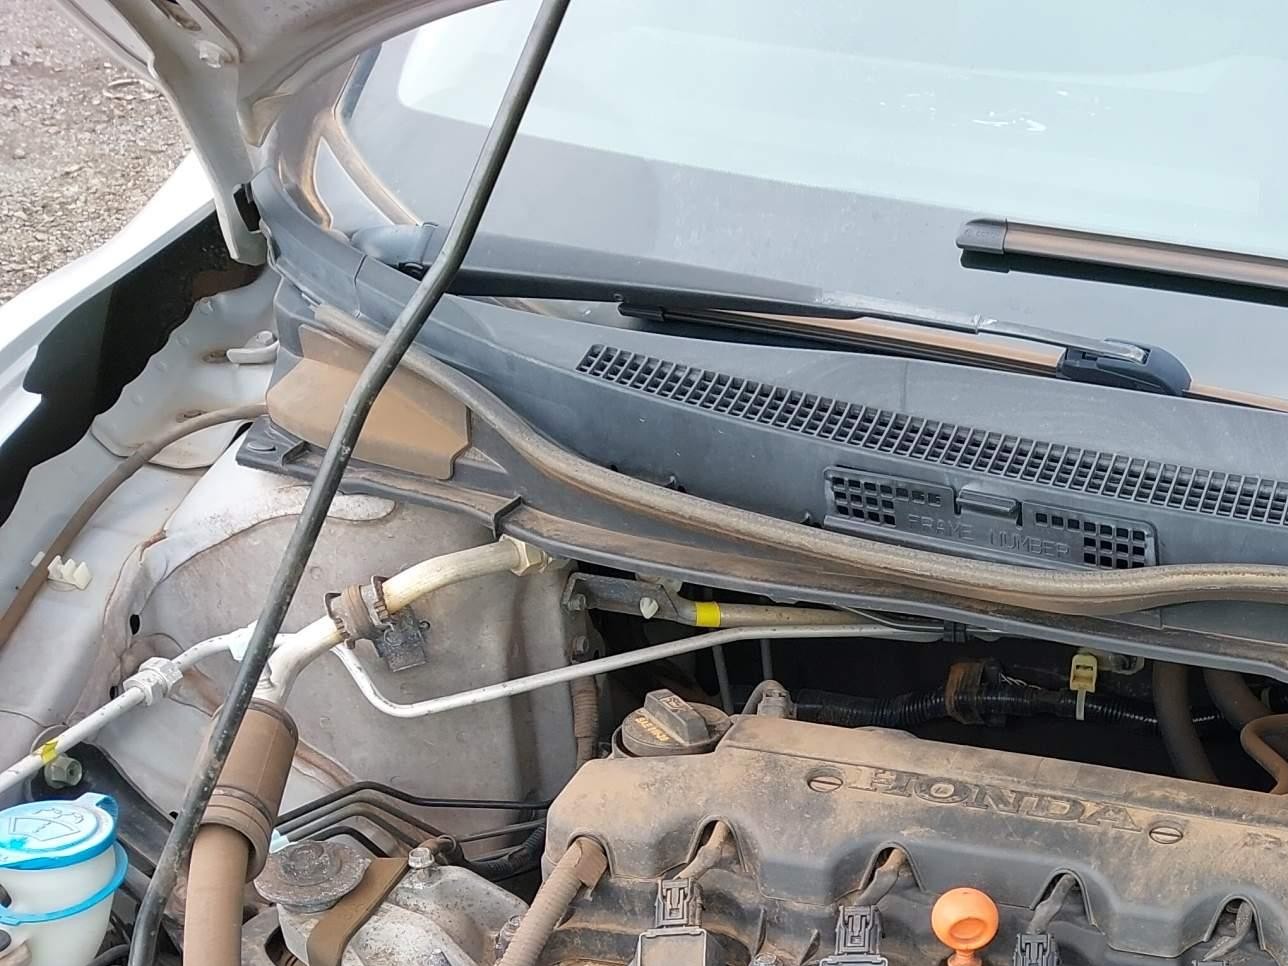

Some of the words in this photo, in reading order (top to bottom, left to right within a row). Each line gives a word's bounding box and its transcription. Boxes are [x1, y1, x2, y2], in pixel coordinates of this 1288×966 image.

[907, 514, 976, 542] FRAME
[990, 530, 1071, 558] NUMBER
[848, 766, 1143, 833] HONDA
